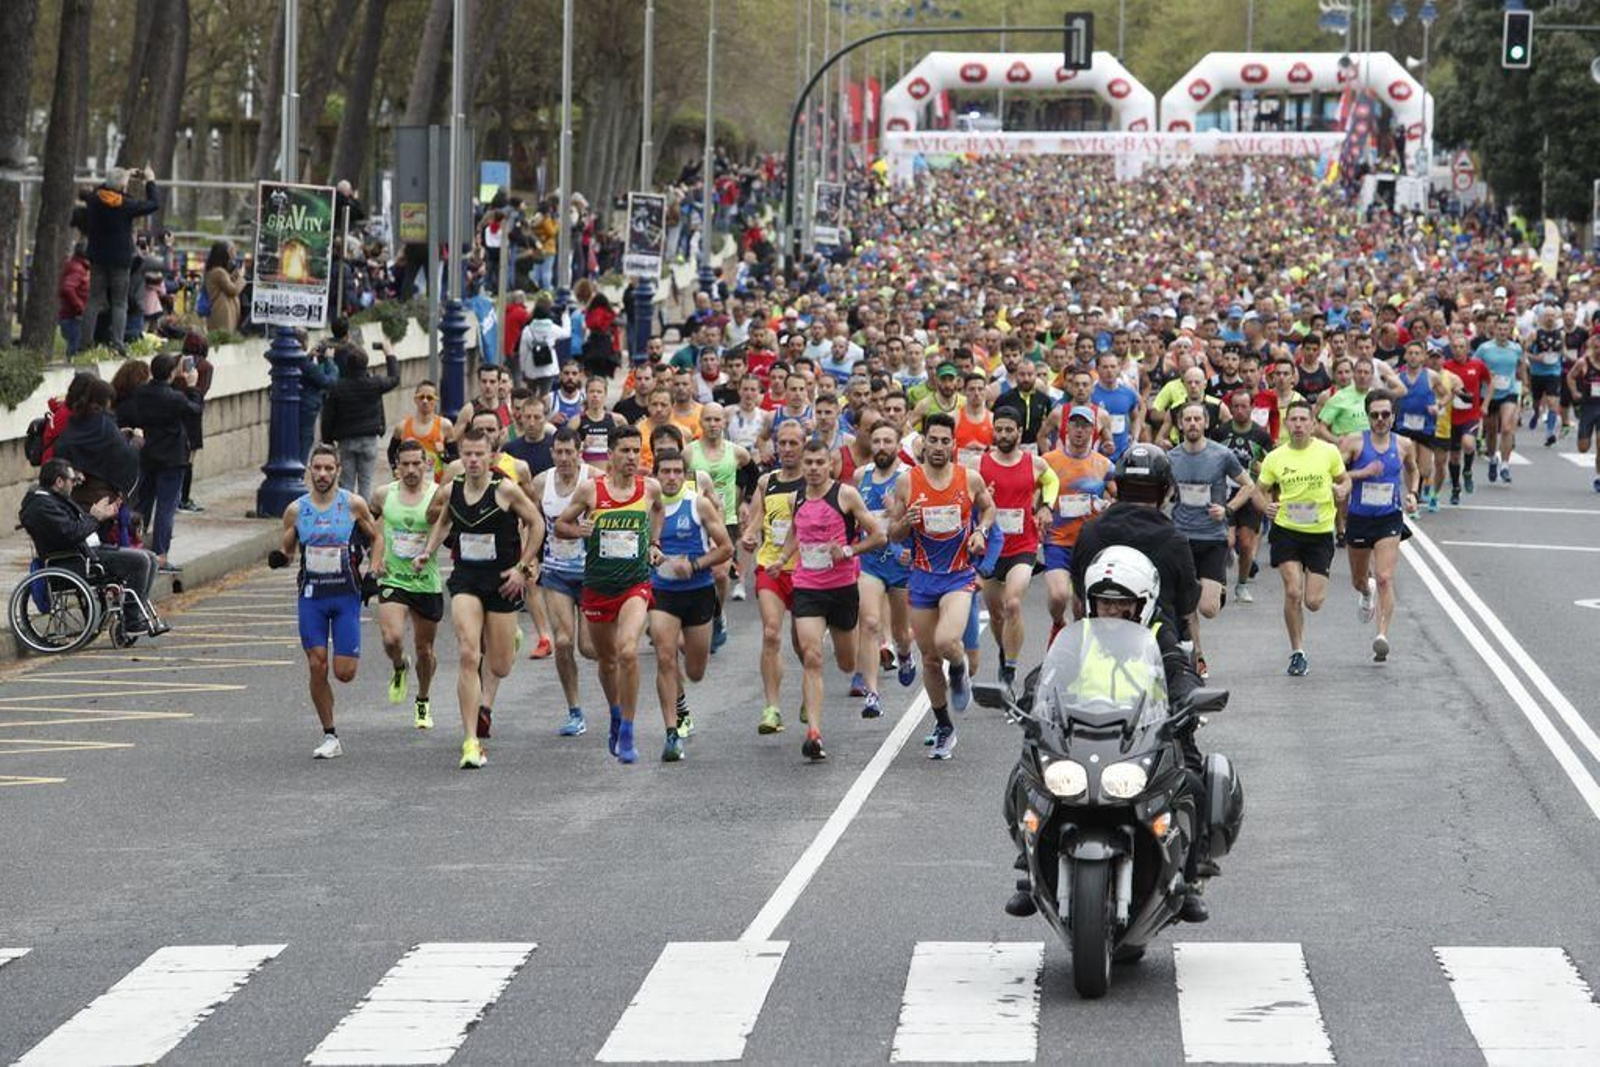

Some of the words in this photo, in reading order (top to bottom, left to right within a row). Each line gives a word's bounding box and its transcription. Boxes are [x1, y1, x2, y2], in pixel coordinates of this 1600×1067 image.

[918, 137, 1007, 151] VIG-BAY
[1073, 137, 1164, 151] VIG-BAY
[1234, 138, 1325, 152] VIG-BAY
[266, 204, 323, 232] GRAVITY
